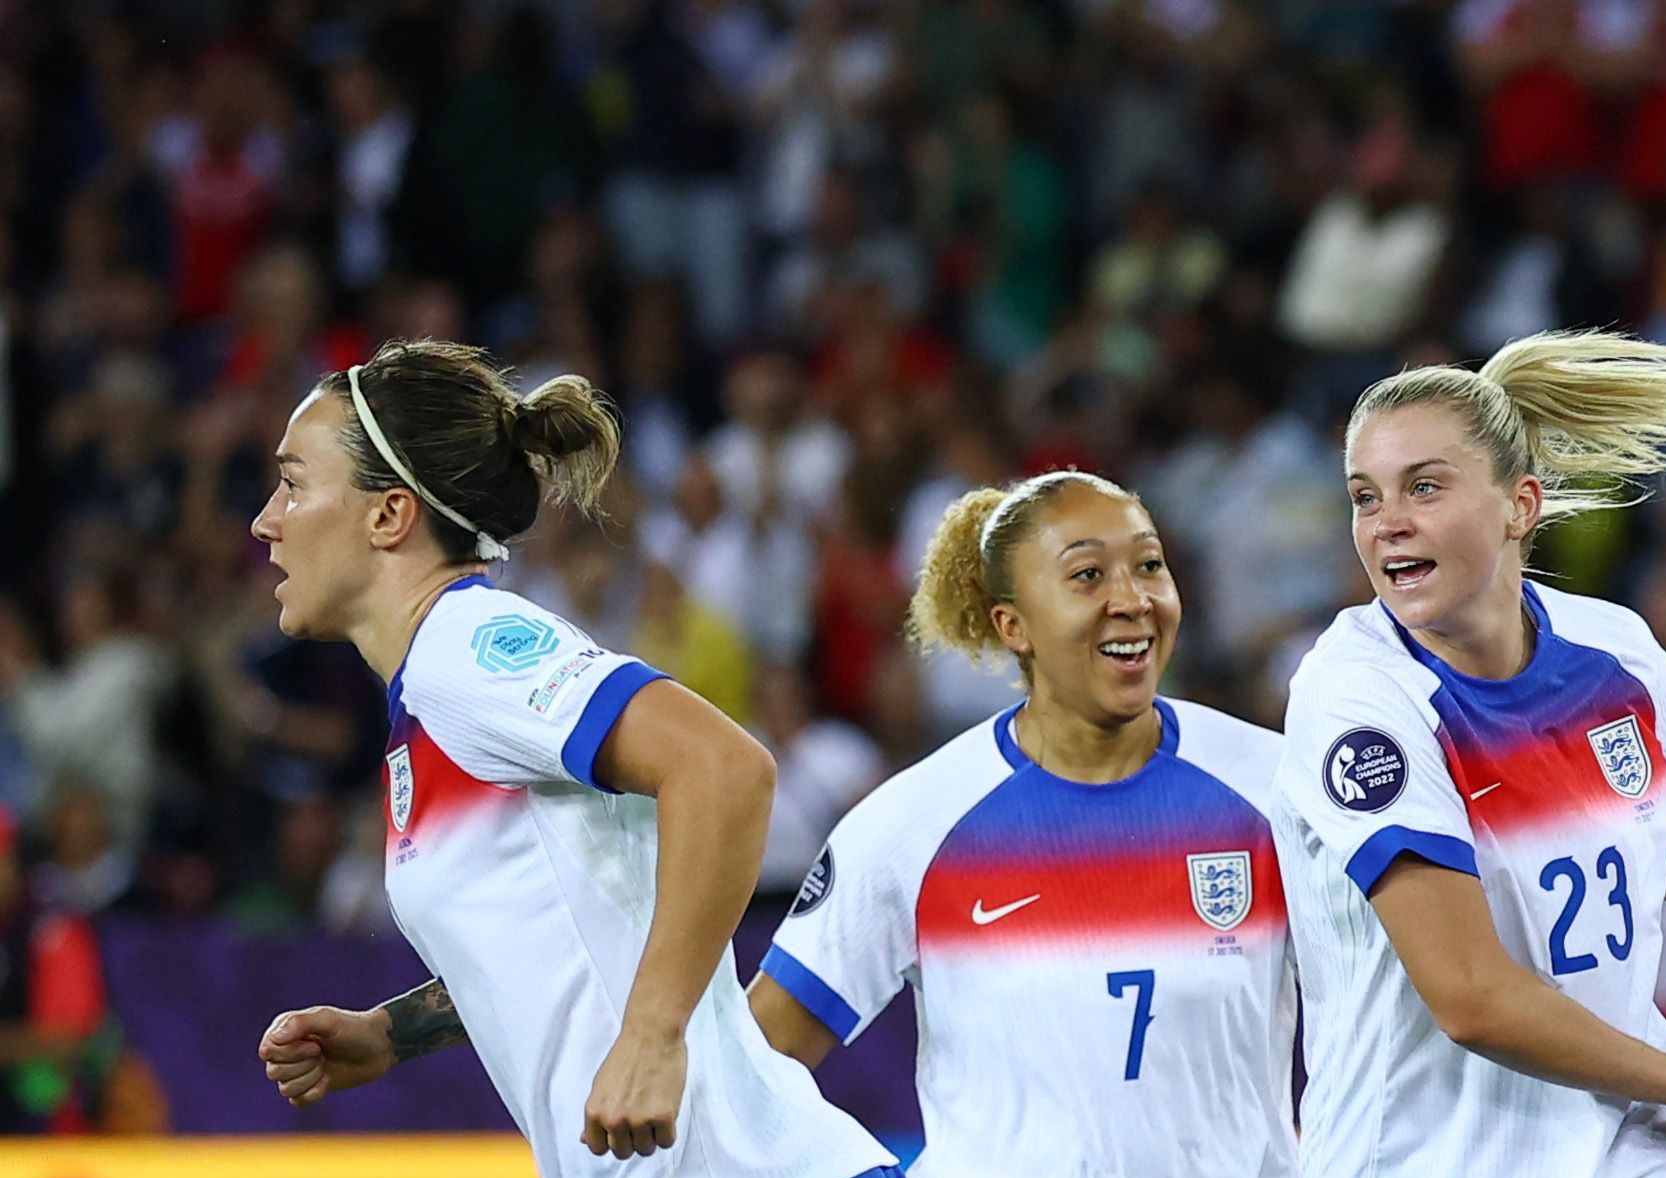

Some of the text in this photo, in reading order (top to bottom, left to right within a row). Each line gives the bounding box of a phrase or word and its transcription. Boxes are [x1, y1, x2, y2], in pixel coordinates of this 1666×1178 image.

[1355, 754, 1398, 773] EUROPEAN
[1355, 761, 1402, 780] CHAMPIONS
[1367, 773, 1395, 788] 2022
[1539, 845, 1633, 976] 23
[1106, 969, 1155, 1081] 7
